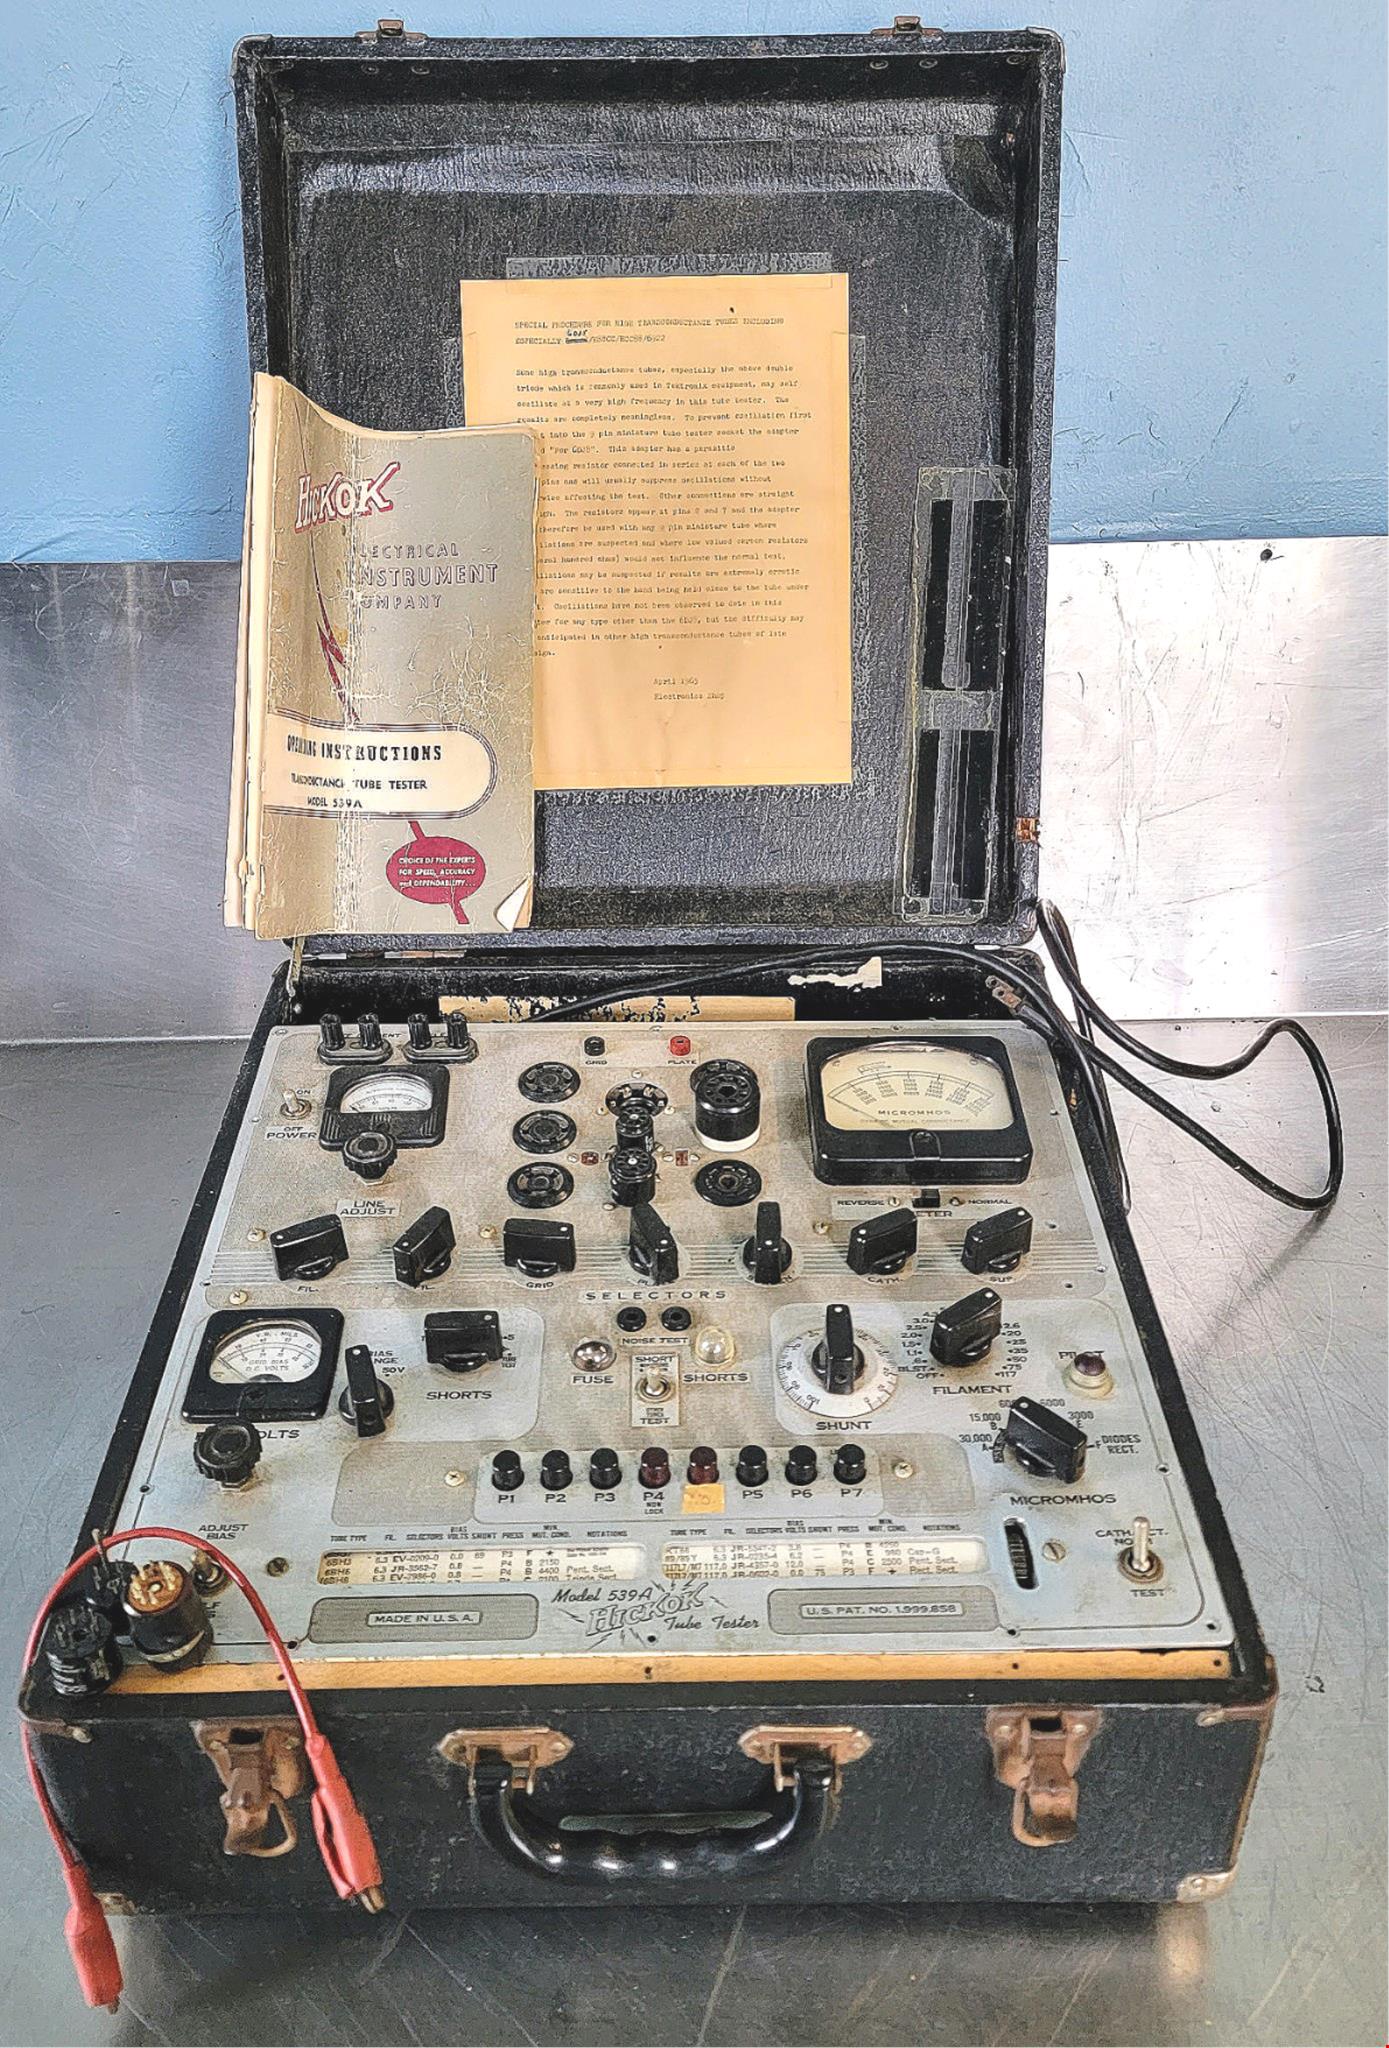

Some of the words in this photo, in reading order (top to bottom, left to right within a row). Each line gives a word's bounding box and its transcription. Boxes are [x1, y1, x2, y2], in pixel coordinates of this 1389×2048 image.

[358, 542, 460, 559] LECTRICAL
[358, 563, 498, 587] NSTRUMENT
[359, 593, 442, 610] OMPANY
[320, 742, 442, 762] INSTRUCTIONS
[352, 778, 382, 790] TUBE
[388, 780, 428, 790] TESTER
[307, 796, 328, 808] MODEL
[266, 1132, 318, 1140] POWER
[340, 1208, 396, 1216] ADJUST
[868, 1276, 903, 1284] CATH.
[586, 1291, 727, 1300] SELECTORS
[572, 1375, 615, 1384] FUSE
[683, 1373, 749, 1382] SHORTS
[932, 1384, 1012, 1395] FILAMENT
[426, 1390, 492, 1400] SHORTS
[968, 1414, 1002, 1422] 15,000
[1068, 1411, 1094, 1420] 3000
[816, 1421, 872, 1431] SHUNT
[259, 1428, 300, 1440] OLTS
[958, 1434, 993, 1443] 30,000
[1102, 1434, 1142, 1444] DIODES
[982, 1444, 988, 1452] A
[1108, 1444, 1139, 1454] RECT.
[498, 1494, 515, 1504] P1
[545, 1494, 567, 1503] P2
[594, 1492, 616, 1502] P3
[643, 1492, 665, 1502] P4
[742, 1490, 764, 1499] P5
[791, 1488, 814, 1498] P6
[840, 1488, 863, 1497] P7
[1010, 1494, 1117, 1506] MICROMHOS
[198, 1524, 250, 1532] ADJUST
[550, 1588, 602, 1604] Model
[608, 1587, 653, 1601] 539A
[1130, 1589, 1165, 1598] TEST
[836, 1606, 864, 1615] PAT.
[868, 1606, 892, 1614] NO.
[374, 1614, 412, 1622] MADE
[664, 1615, 702, 1630] Tube
[712, 1614, 760, 1630] Tester
